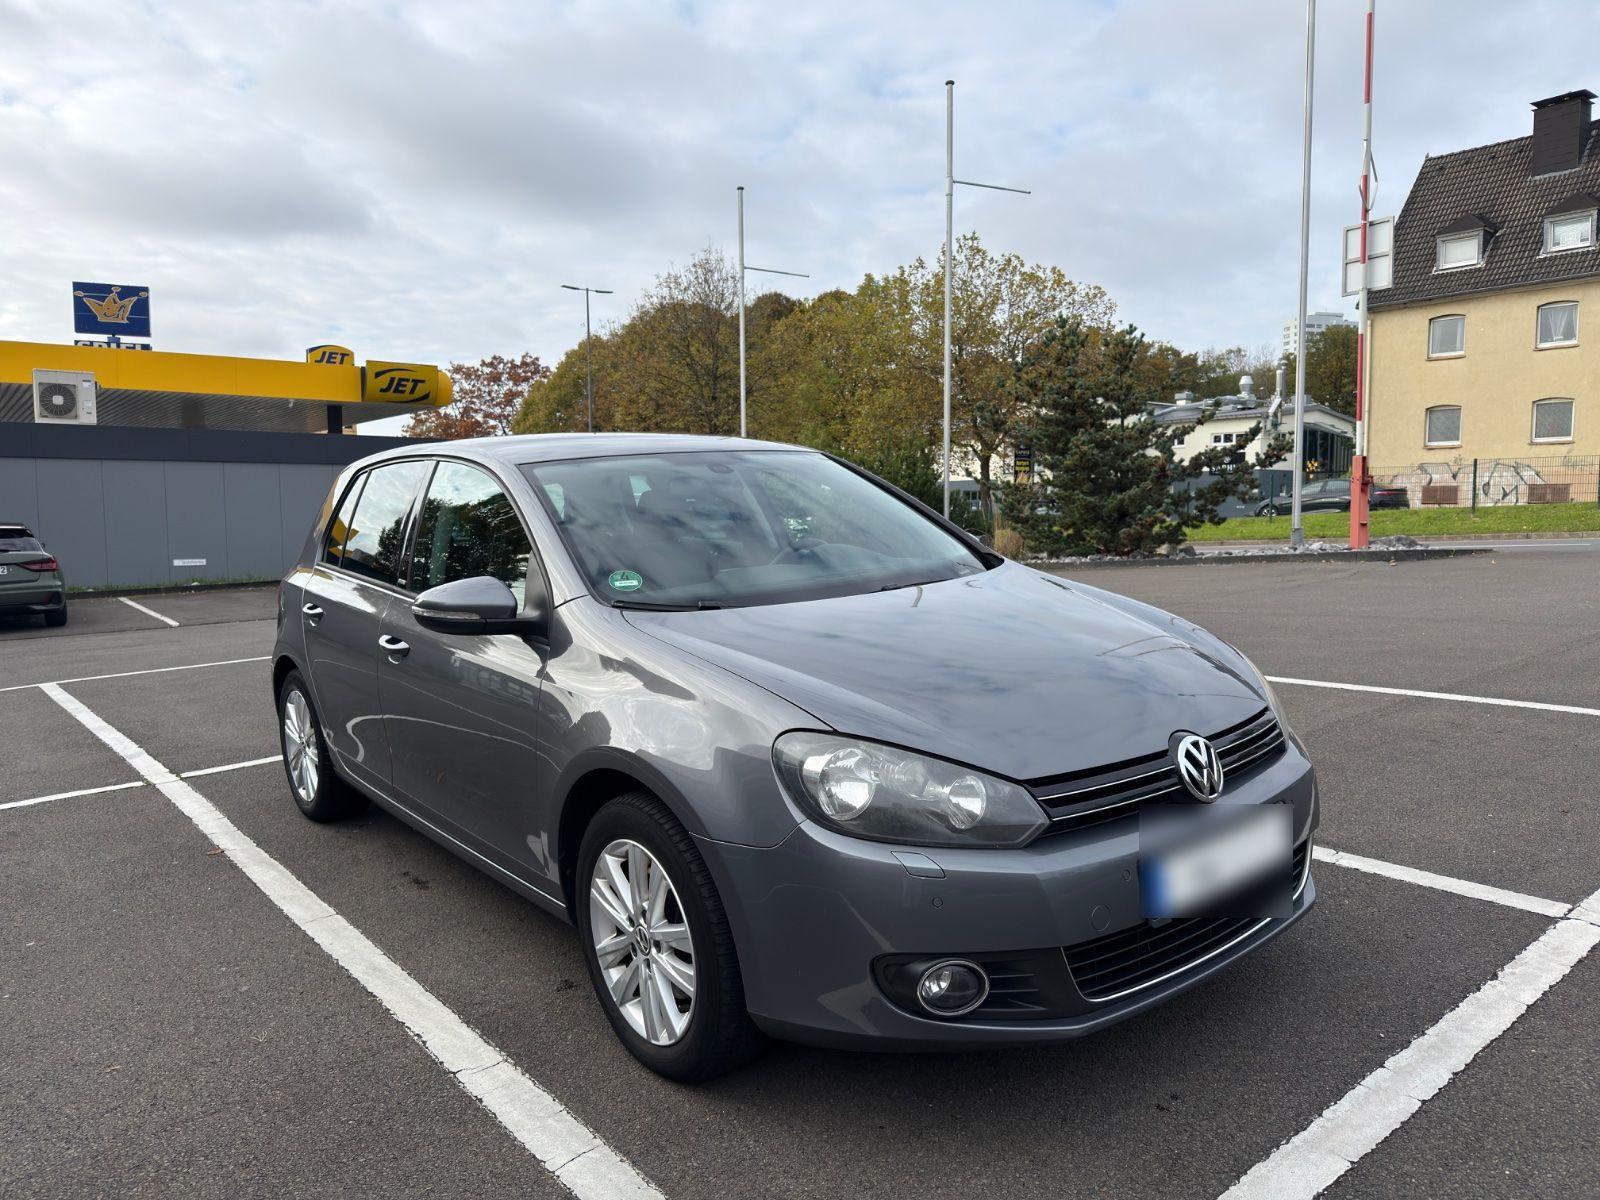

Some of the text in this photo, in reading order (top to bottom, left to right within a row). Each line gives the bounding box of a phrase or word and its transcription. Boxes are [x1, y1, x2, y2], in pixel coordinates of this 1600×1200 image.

[315, 351, 350, 364] JET
[379, 376, 426, 394] JET
[1178, 735, 1224, 803] VW
